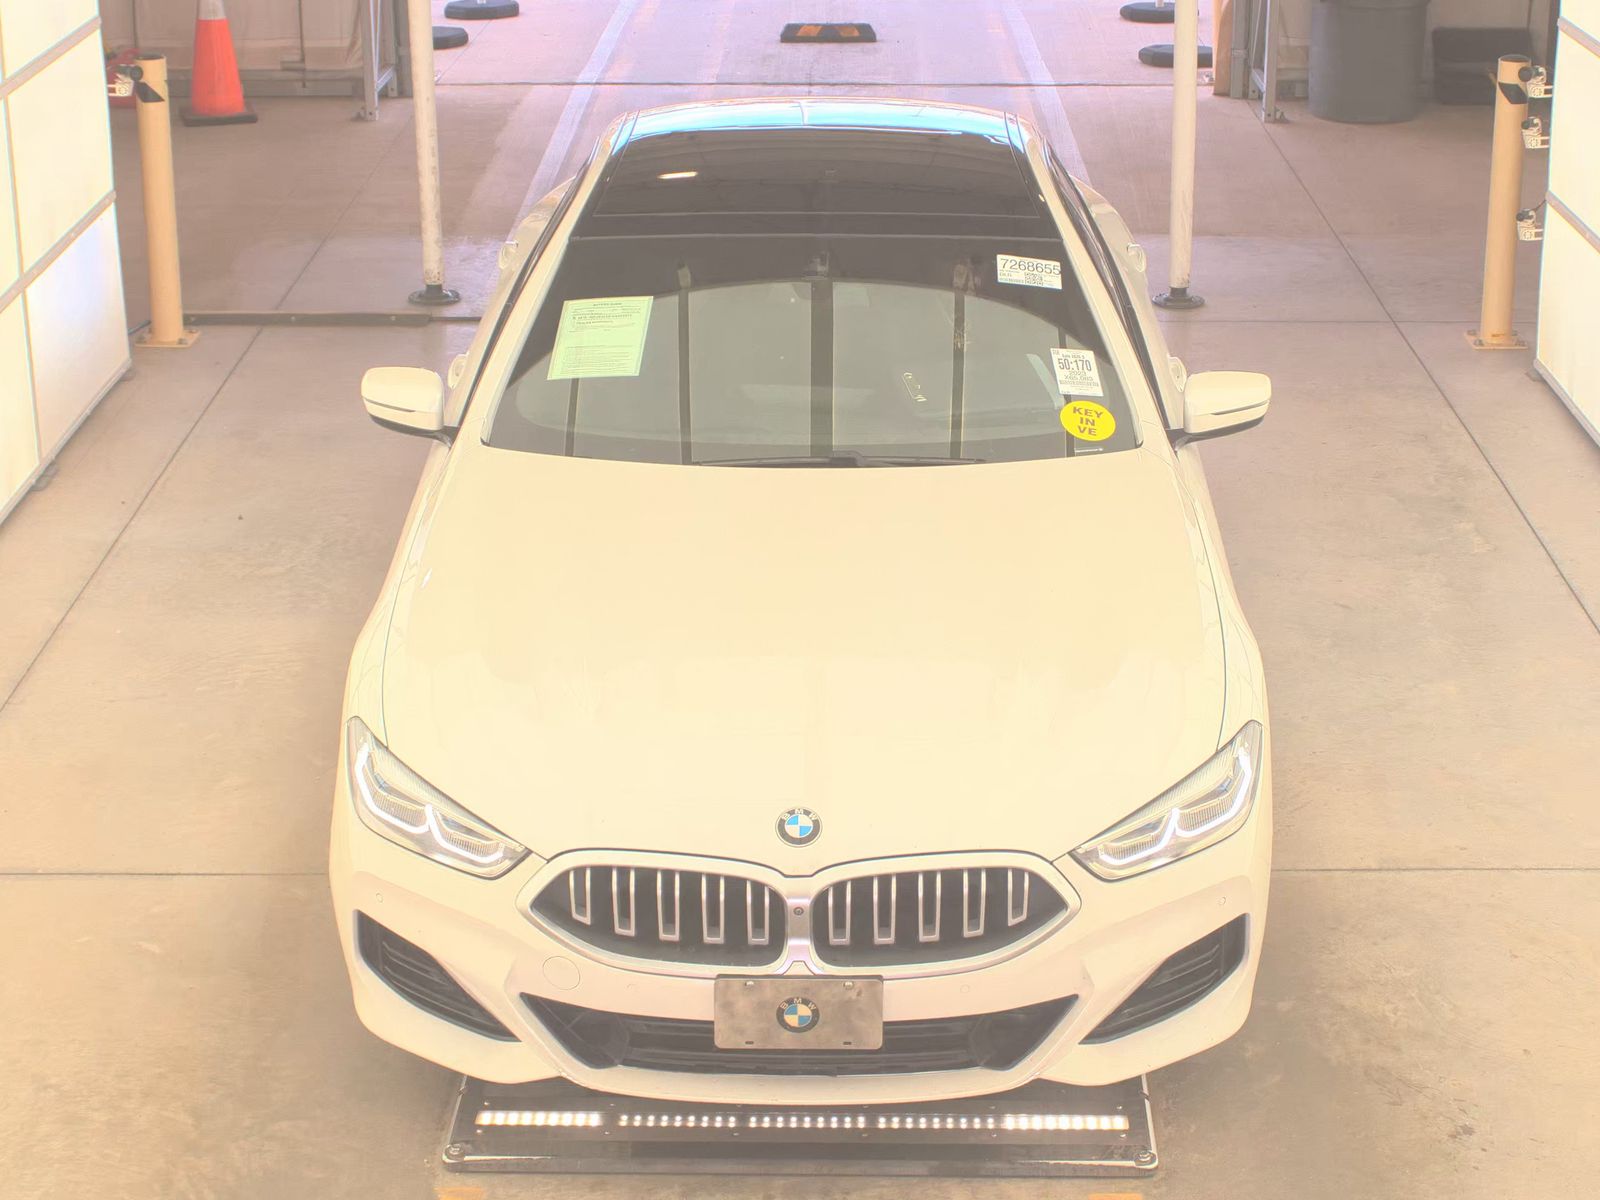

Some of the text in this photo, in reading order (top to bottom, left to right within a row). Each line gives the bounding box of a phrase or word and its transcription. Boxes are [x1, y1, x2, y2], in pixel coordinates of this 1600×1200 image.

[1000, 258, 1061, 275] 7268655
[1058, 358, 1092, 371] 50:170
[1073, 406, 1104, 418] KEY
[1080, 417, 1096, 426] IN
[1078, 425, 1097, 436] VE
[780, 808, 818, 821] BMW
[779, 998, 817, 1010] BMW
